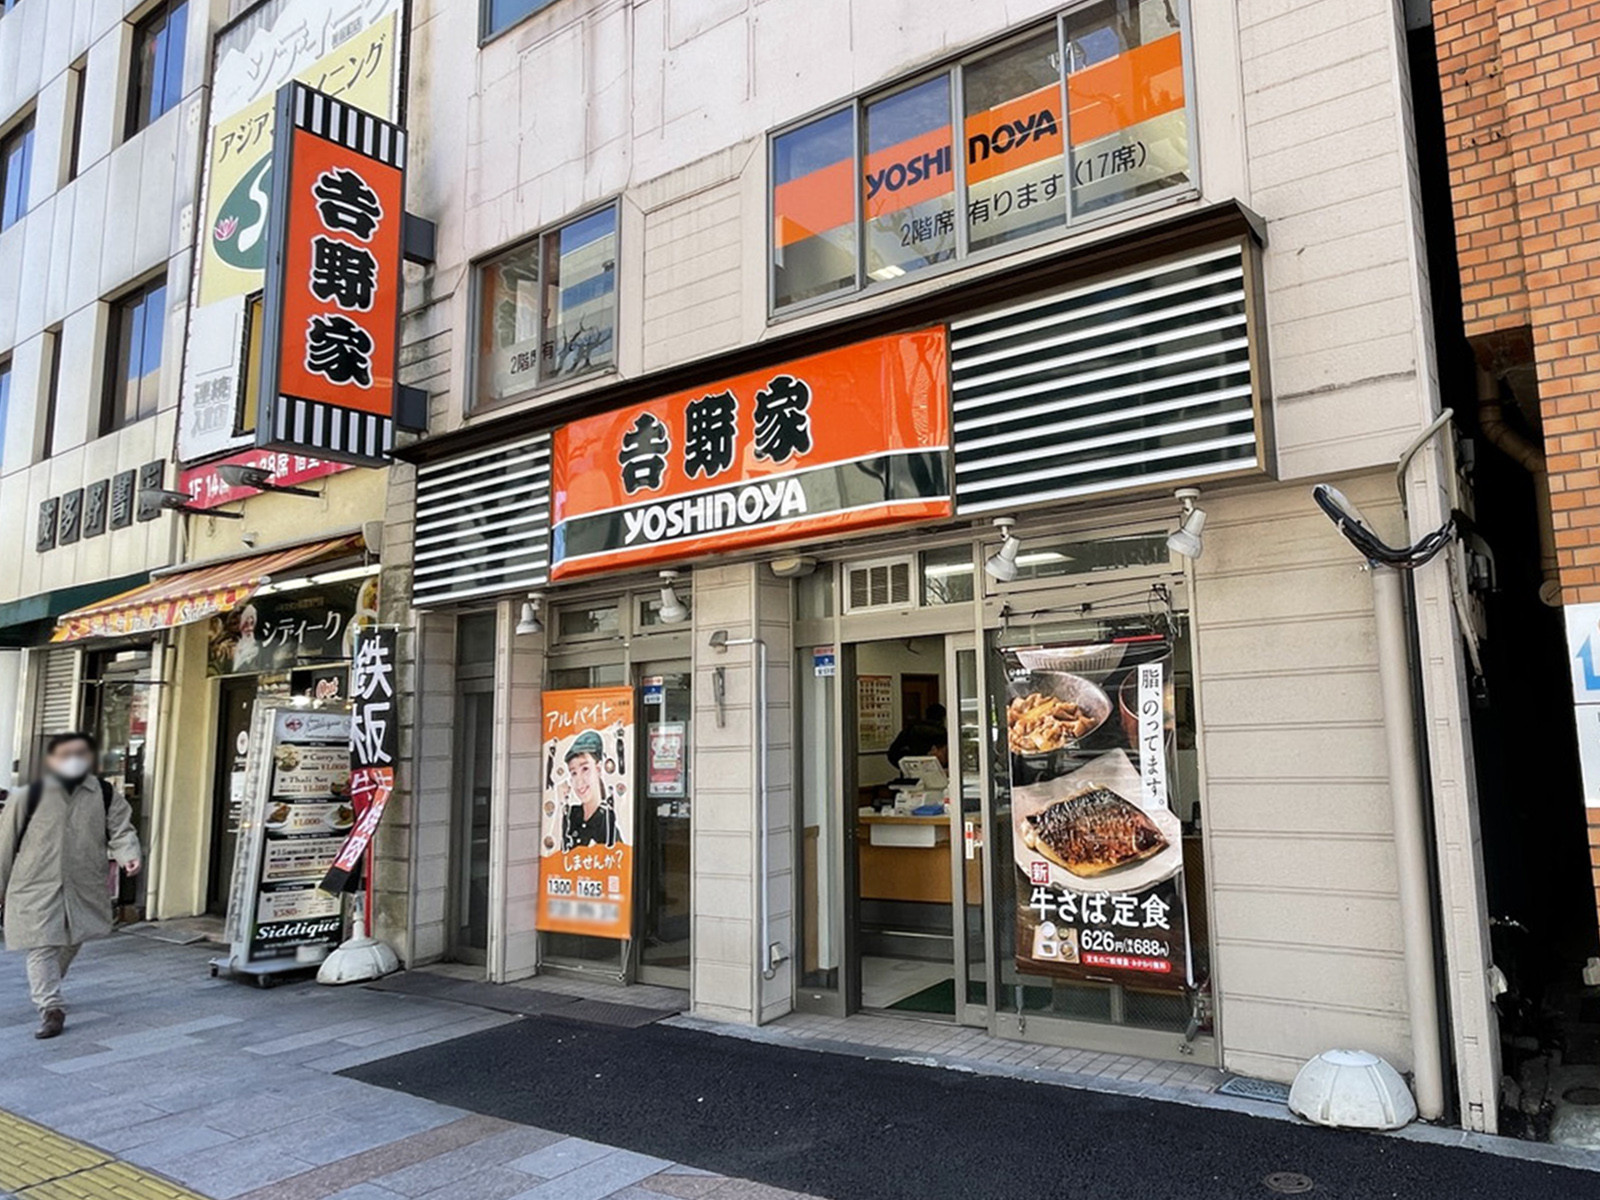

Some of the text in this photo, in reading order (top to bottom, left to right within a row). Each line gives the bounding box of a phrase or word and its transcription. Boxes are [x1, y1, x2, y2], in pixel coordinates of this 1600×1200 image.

[303, 166, 384, 391] 吉野家
[618, 374, 813, 496] 吉野家
[262, 610, 342, 648] シディーク
[545, 701, 612, 732] アルバイト
[548, 880, 571, 894] 1300
[578, 882, 602, 897] 1625
[1030, 887, 1171, 930] 牛さば定食
[256, 920, 340, 940] Siddique
